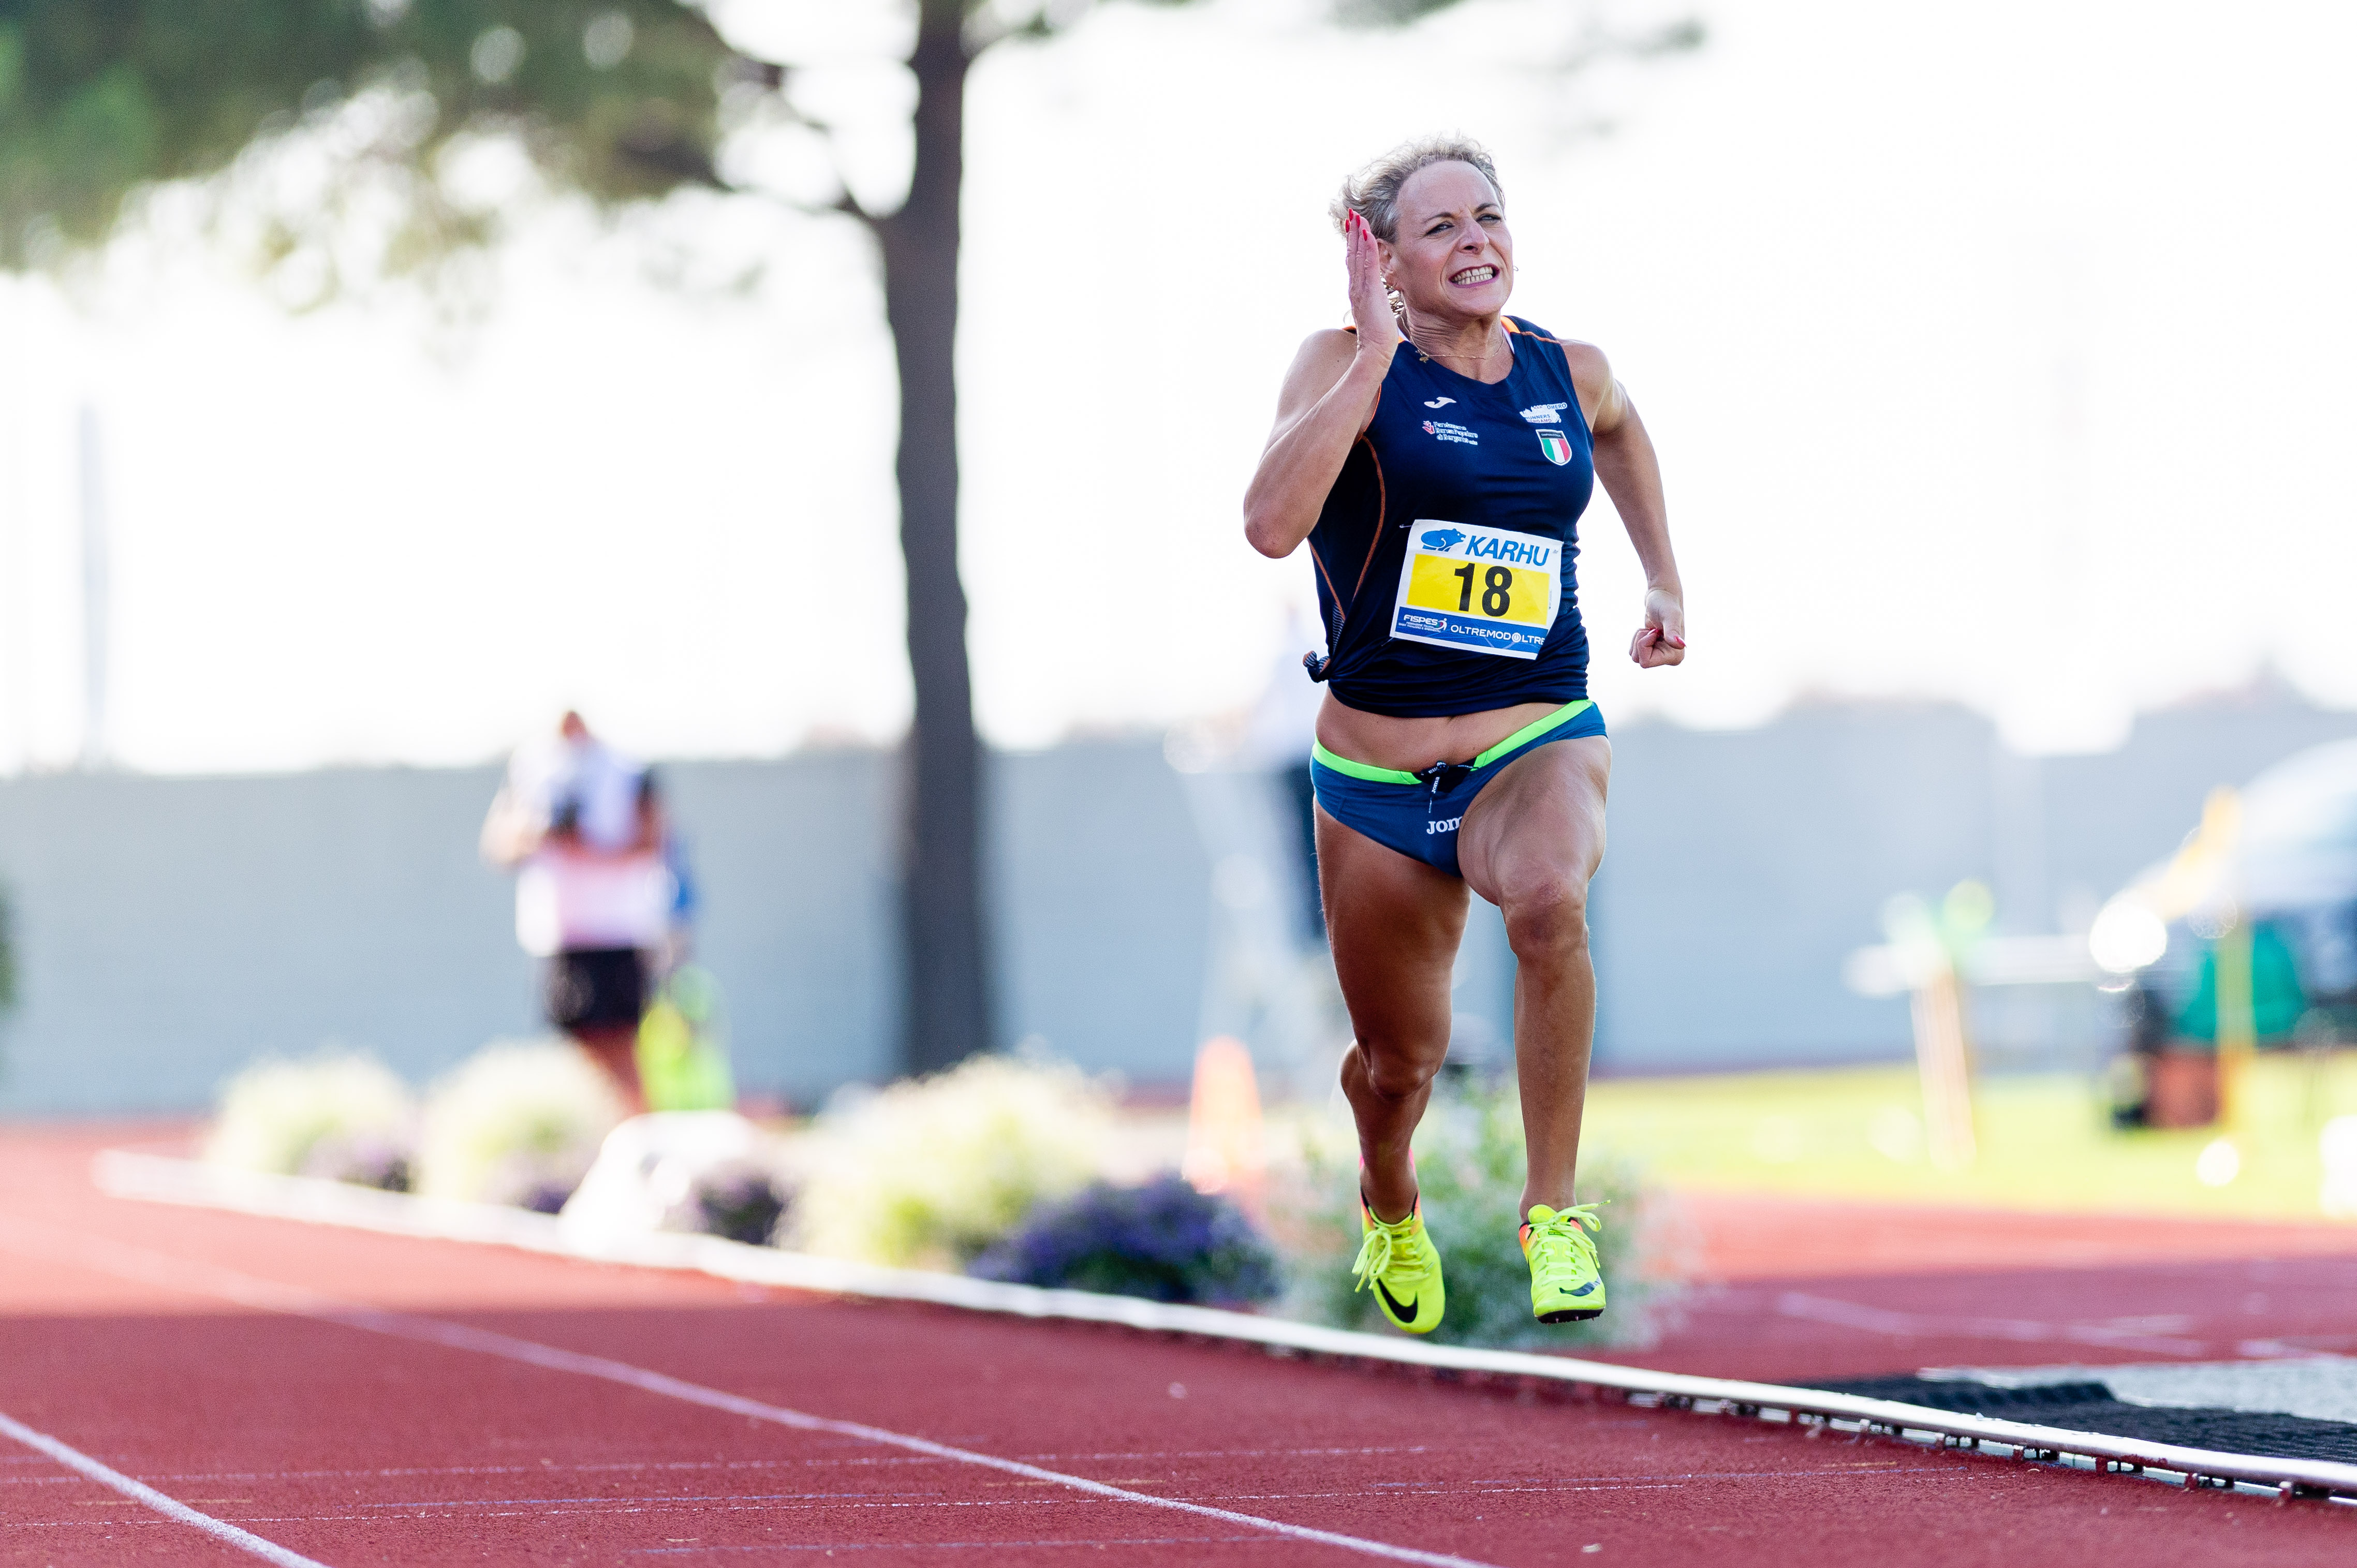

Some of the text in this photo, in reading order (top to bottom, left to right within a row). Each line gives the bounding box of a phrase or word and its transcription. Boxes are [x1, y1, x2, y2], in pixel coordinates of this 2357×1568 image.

[1465, 535, 1550, 566] KARHU
[1454, 563, 1512, 617] 18
[1403, 614, 1438, 626] FISPES
[1426, 816, 1463, 834] Jom
